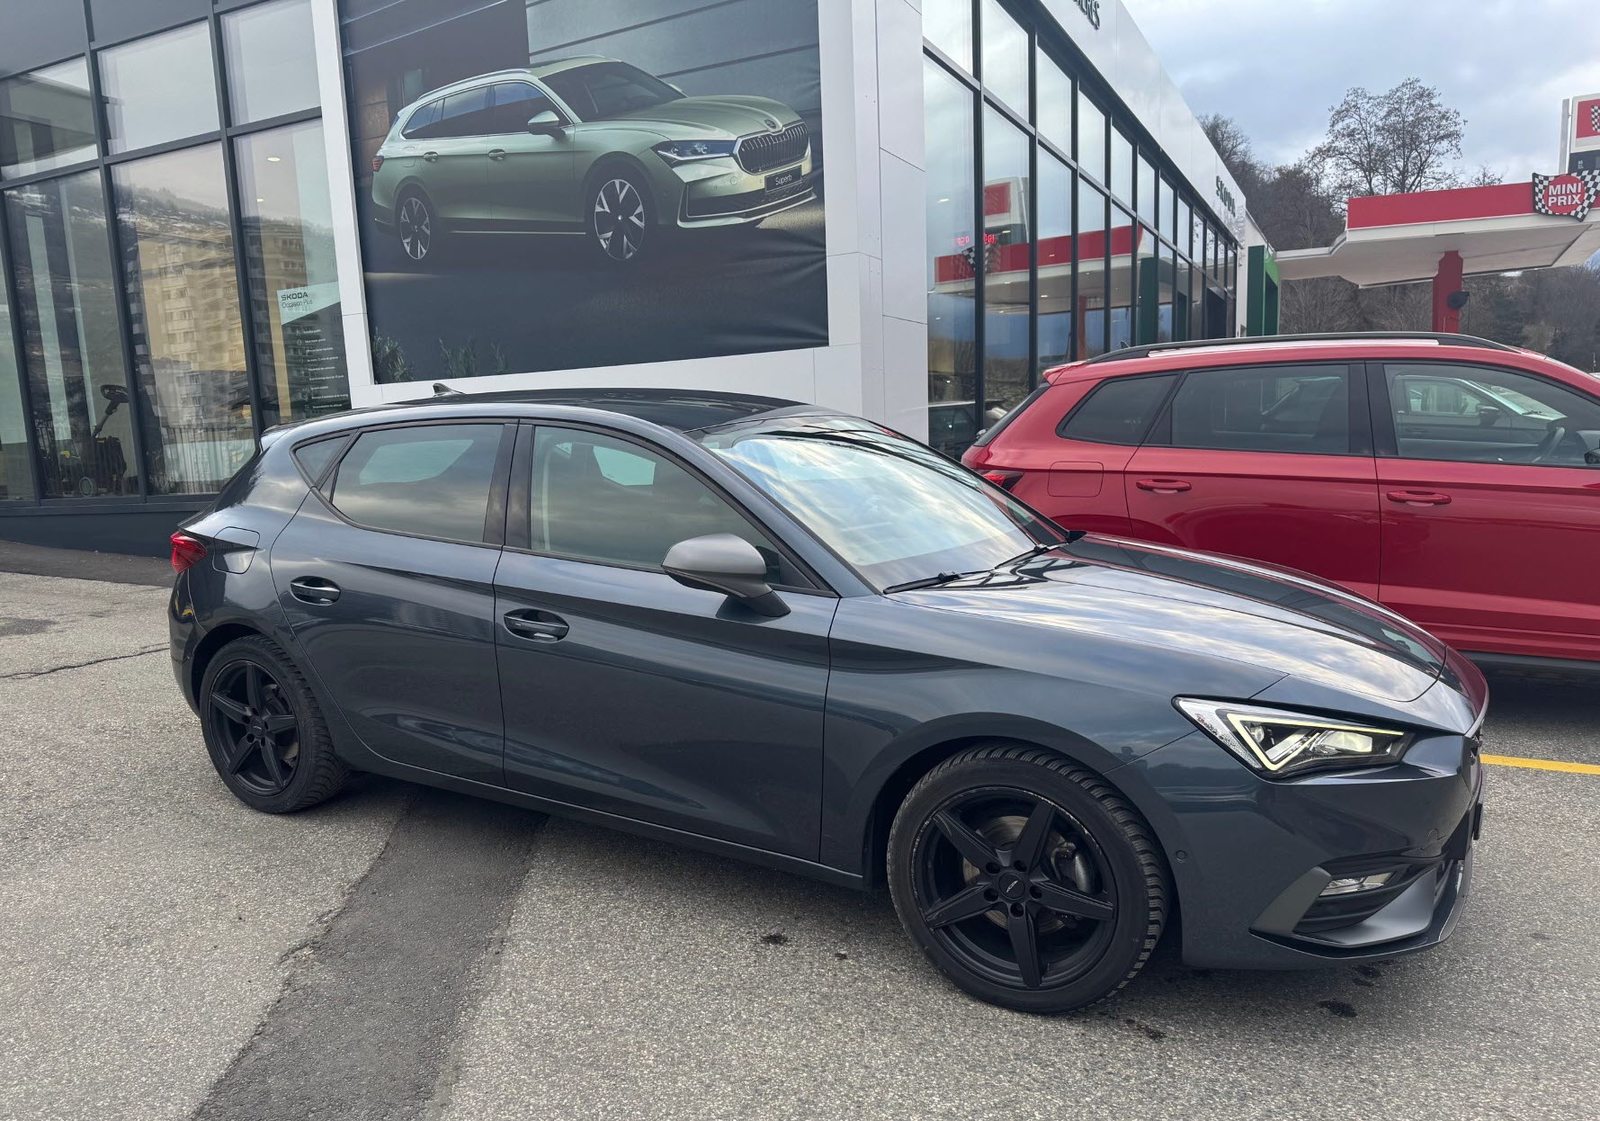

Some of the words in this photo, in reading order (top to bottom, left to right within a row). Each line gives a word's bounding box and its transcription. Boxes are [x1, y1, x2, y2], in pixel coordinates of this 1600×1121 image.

[776, 174, 793, 186] Superb
[1549, 183, 1581, 195] MINI
[1548, 194, 1581, 206] PRIX
